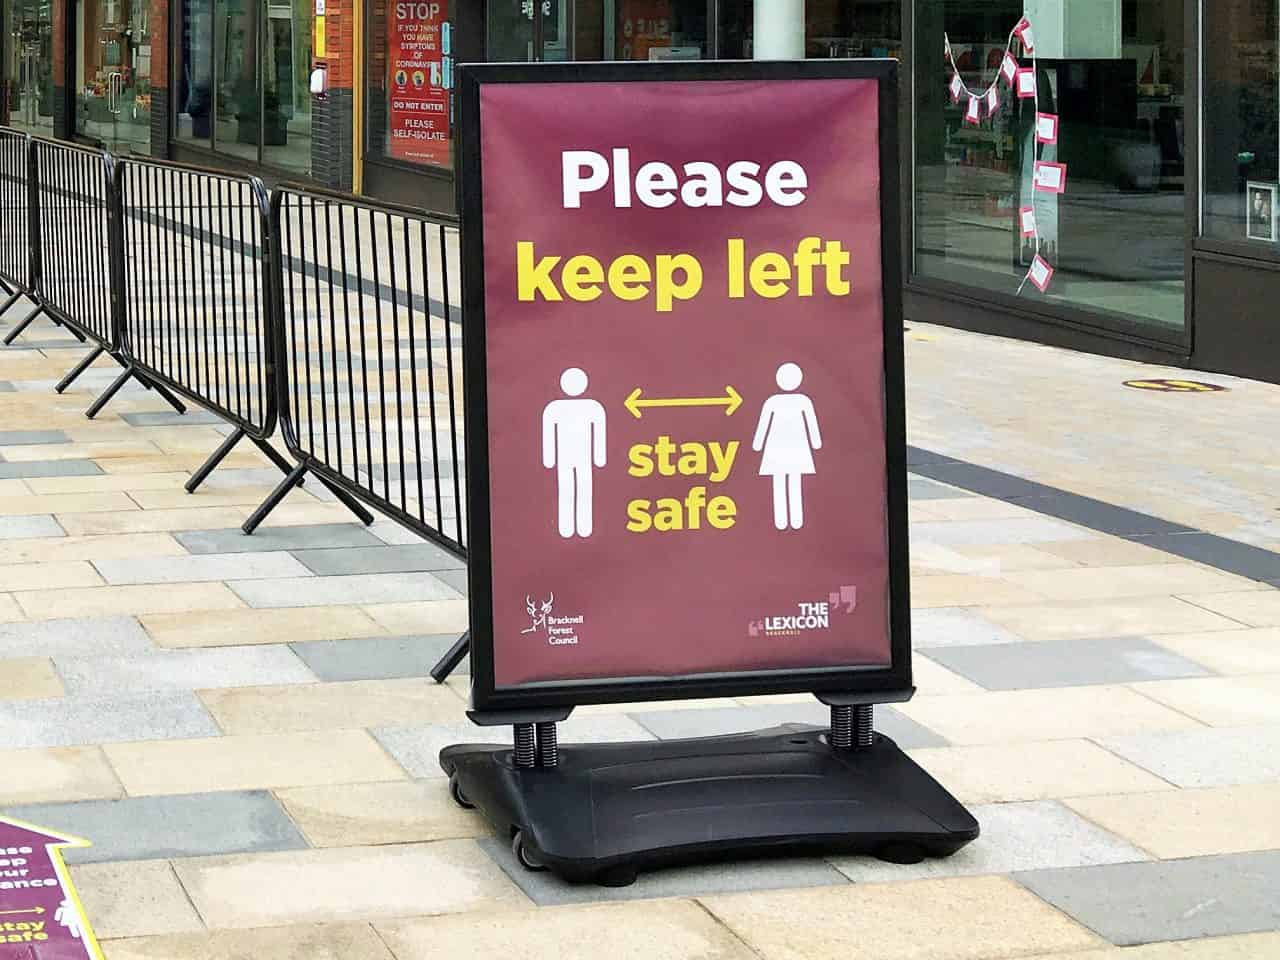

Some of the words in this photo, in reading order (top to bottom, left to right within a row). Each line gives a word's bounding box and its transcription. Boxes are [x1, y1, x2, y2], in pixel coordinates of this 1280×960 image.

[396, 2, 440, 21] STOP
[405, 24, 419, 33] YOU
[402, 33, 416, 41] YOU
[417, 34, 434, 42] HAVE
[393, 101, 404, 110] DO
[405, 102, 419, 111] NOT
[420, 103, 444, 112] ENTER
[404, 119, 435, 129] PLEASE
[393, 128, 446, 141] SELF-ISOLATE
[561, 148, 808, 209] Please
[516, 241, 703, 312] keep
[727, 237, 851, 298] left
[627, 436, 740, 482] stay
[626, 487, 737, 532] safe
[798, 602, 829, 615] THE
[548, 615, 584, 625] Bracknell
[765, 615, 829, 630] LEXICON
[548, 626, 574, 635] Forest
[548, 635, 578, 645] Council
